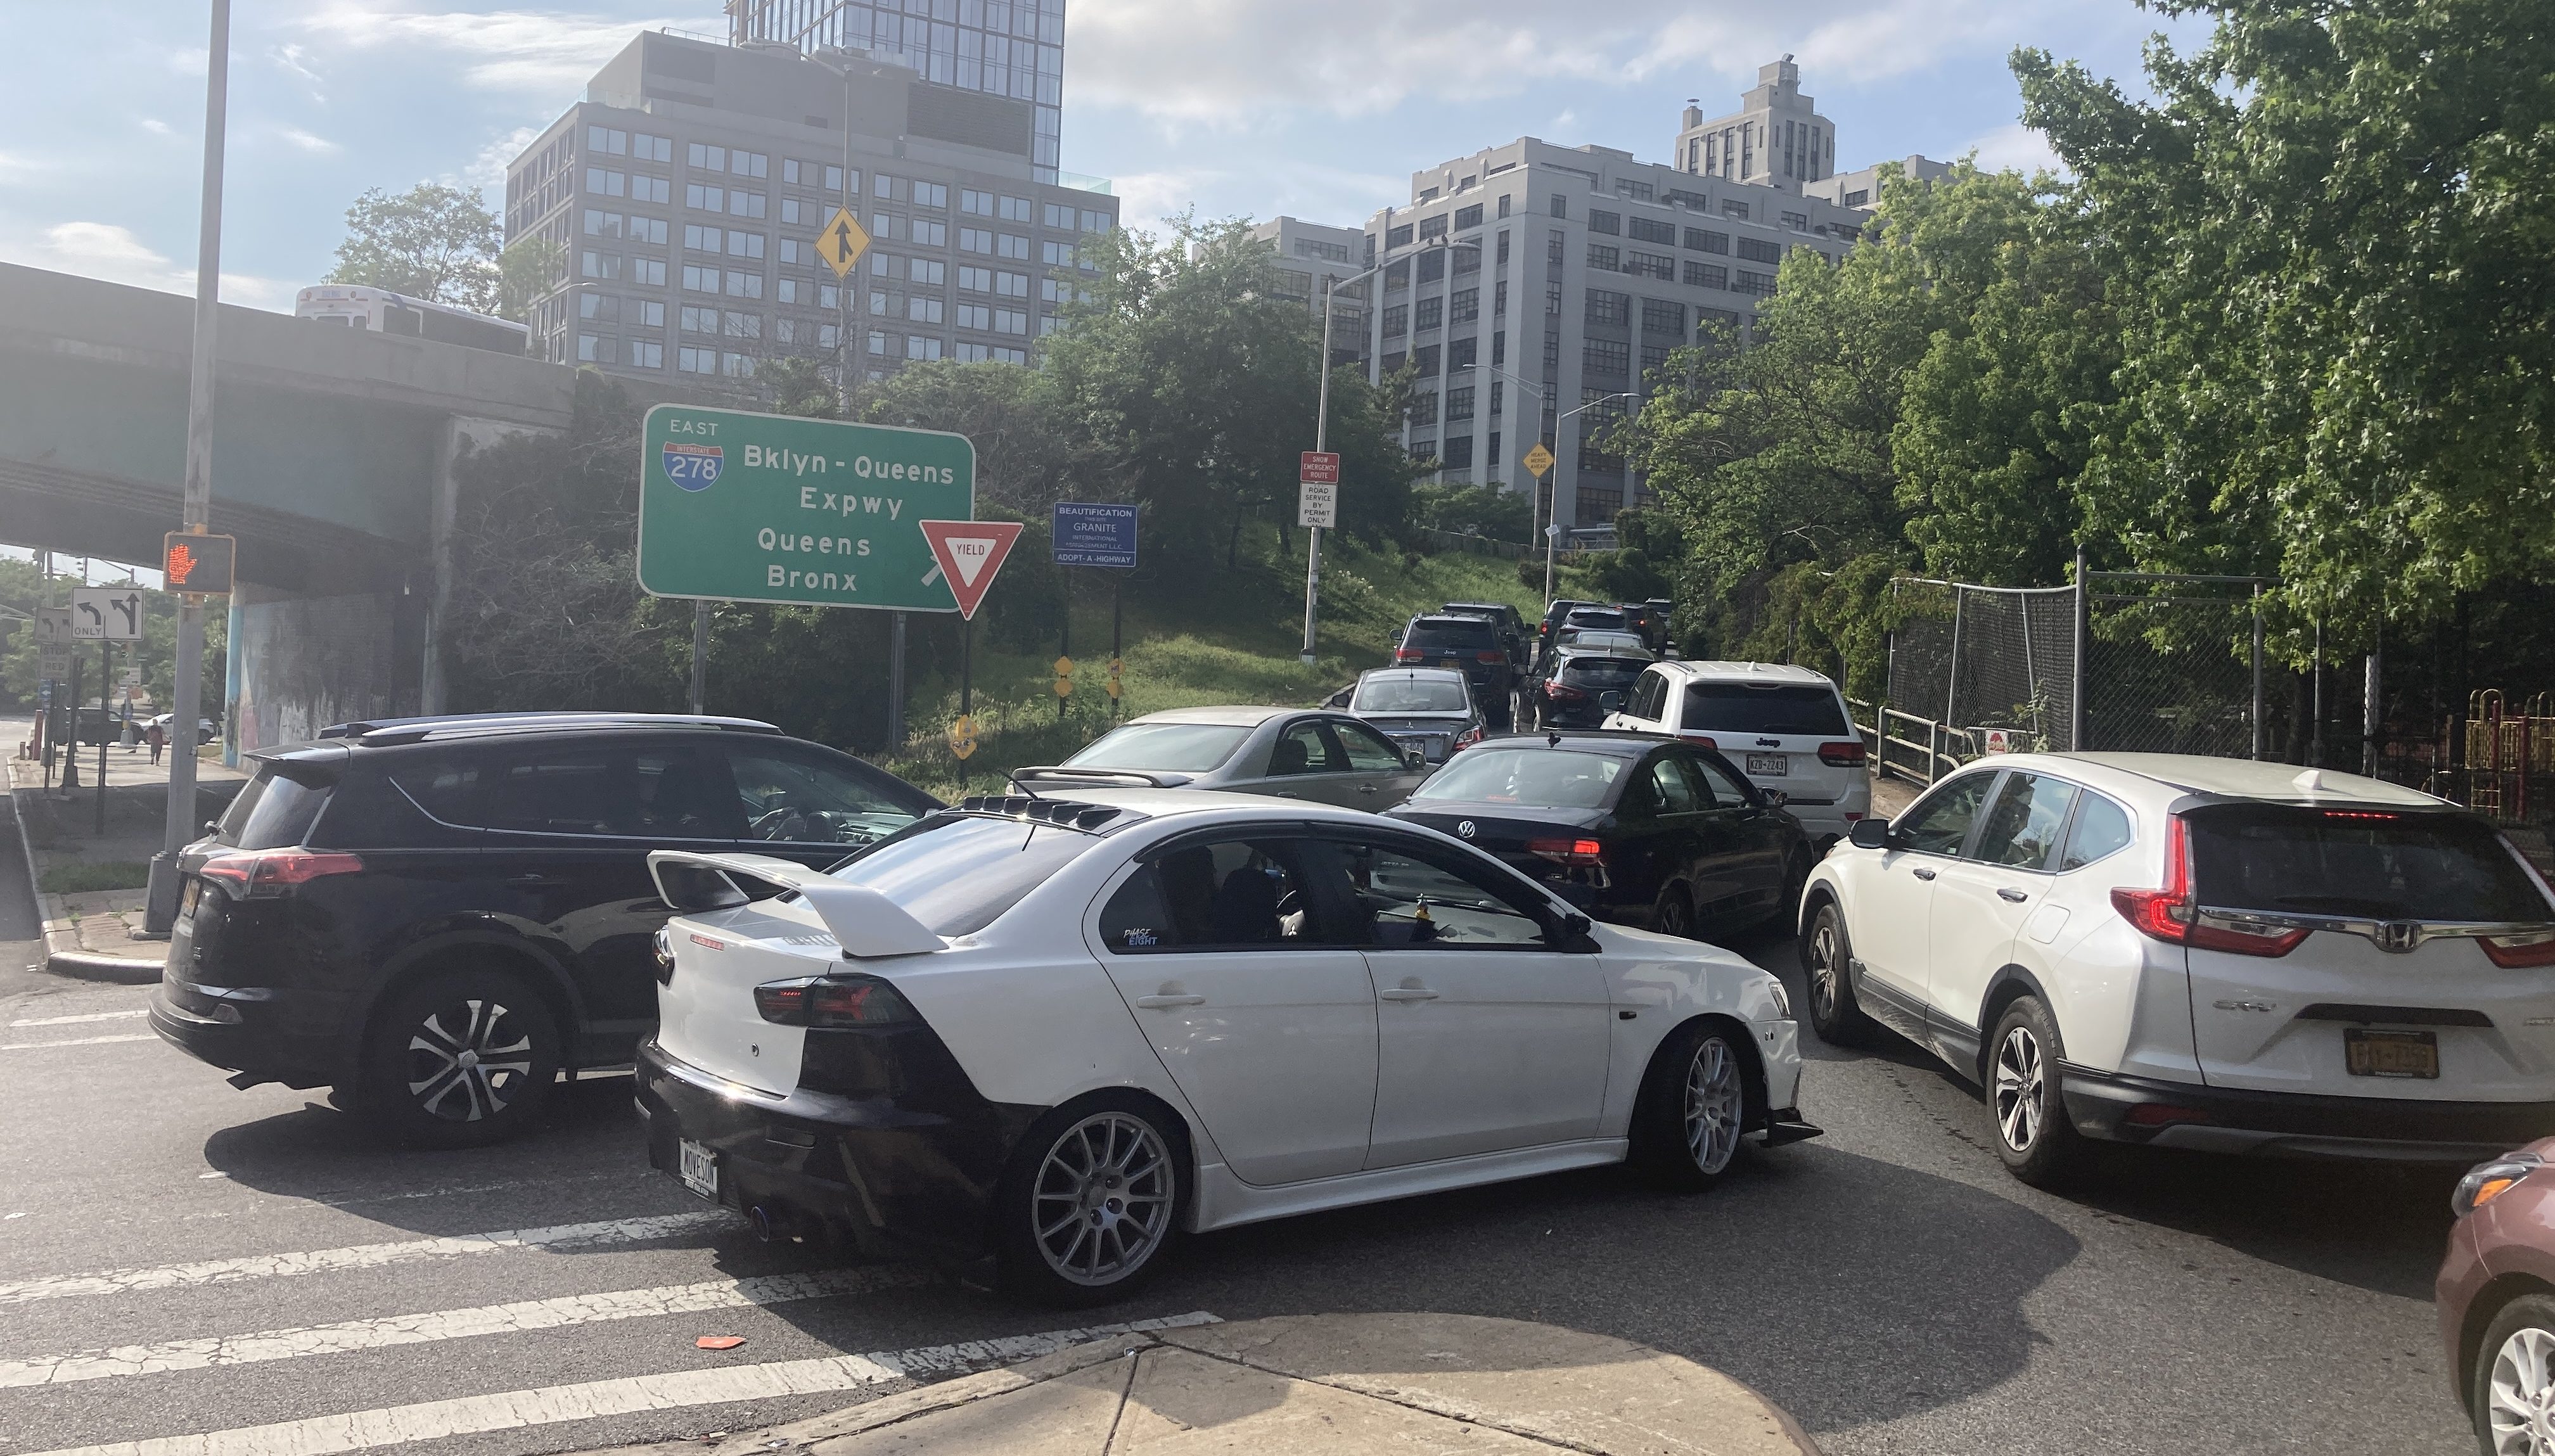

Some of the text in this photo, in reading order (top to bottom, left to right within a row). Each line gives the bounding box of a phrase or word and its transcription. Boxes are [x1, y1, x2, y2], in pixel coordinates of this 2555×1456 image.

[670, 419, 719, 436] EAST
[677, 445, 710, 455] INTERSTATE
[670, 456, 717, 480] 278
[1303, 463, 1336, 471] EMERGENCY
[800, 486, 903, 521] Expwy
[1059, 507, 1132, 518] BEAUTIFICATION
[1073, 522, 1117, 533] GRANITE
[758, 527, 871, 556] Queens
[956, 544, 985, 556] YIELD
[767, 565, 857, 591] Bronx
[74, 627, 102, 635] ONLY
[45, 662, 65, 670] RED
[1755, 737, 1781, 748] Jeep
[1123, 928, 1151, 939] PHASE
[1129, 936, 1158, 946] EIGHT
[684, 1147, 715, 1187] MOVESON
